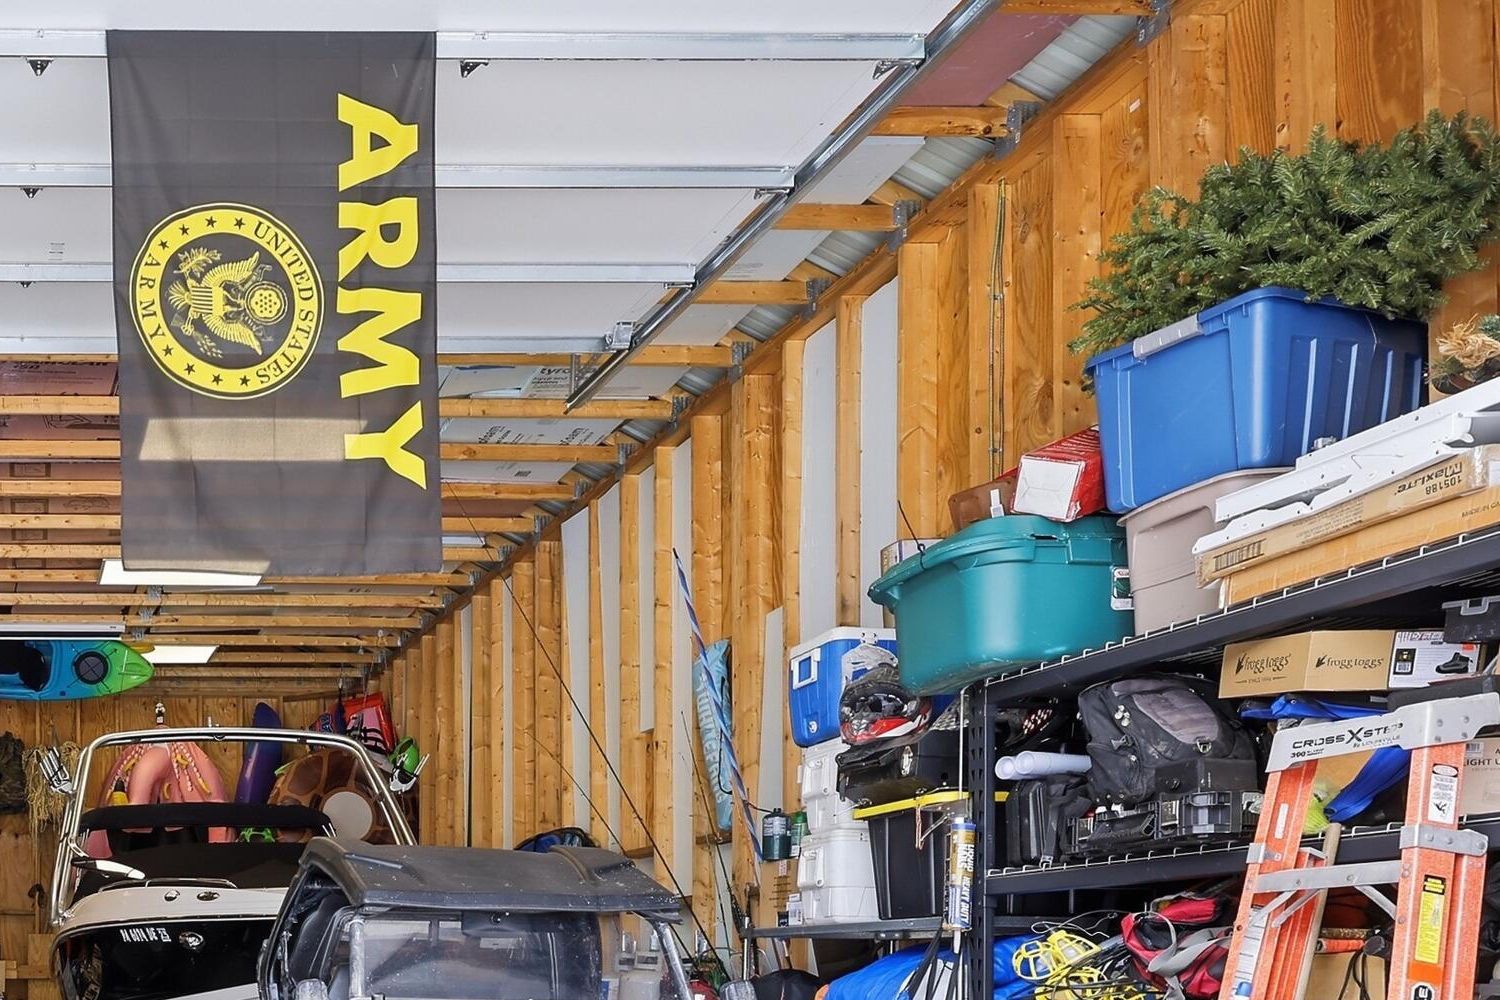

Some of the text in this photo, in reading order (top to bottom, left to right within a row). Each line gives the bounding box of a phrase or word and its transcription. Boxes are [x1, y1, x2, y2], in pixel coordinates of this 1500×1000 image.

[138, 252, 166, 340] ARMY
[253, 219, 315, 385] UNITED STATES
[337, 93, 427, 490] ARMY
[1424, 474, 1463, 496] 105188
[1244, 657, 1266, 675] frogg
[1326, 656, 1351, 670] frogg
[1463, 758, 1491, 767] IGHT
